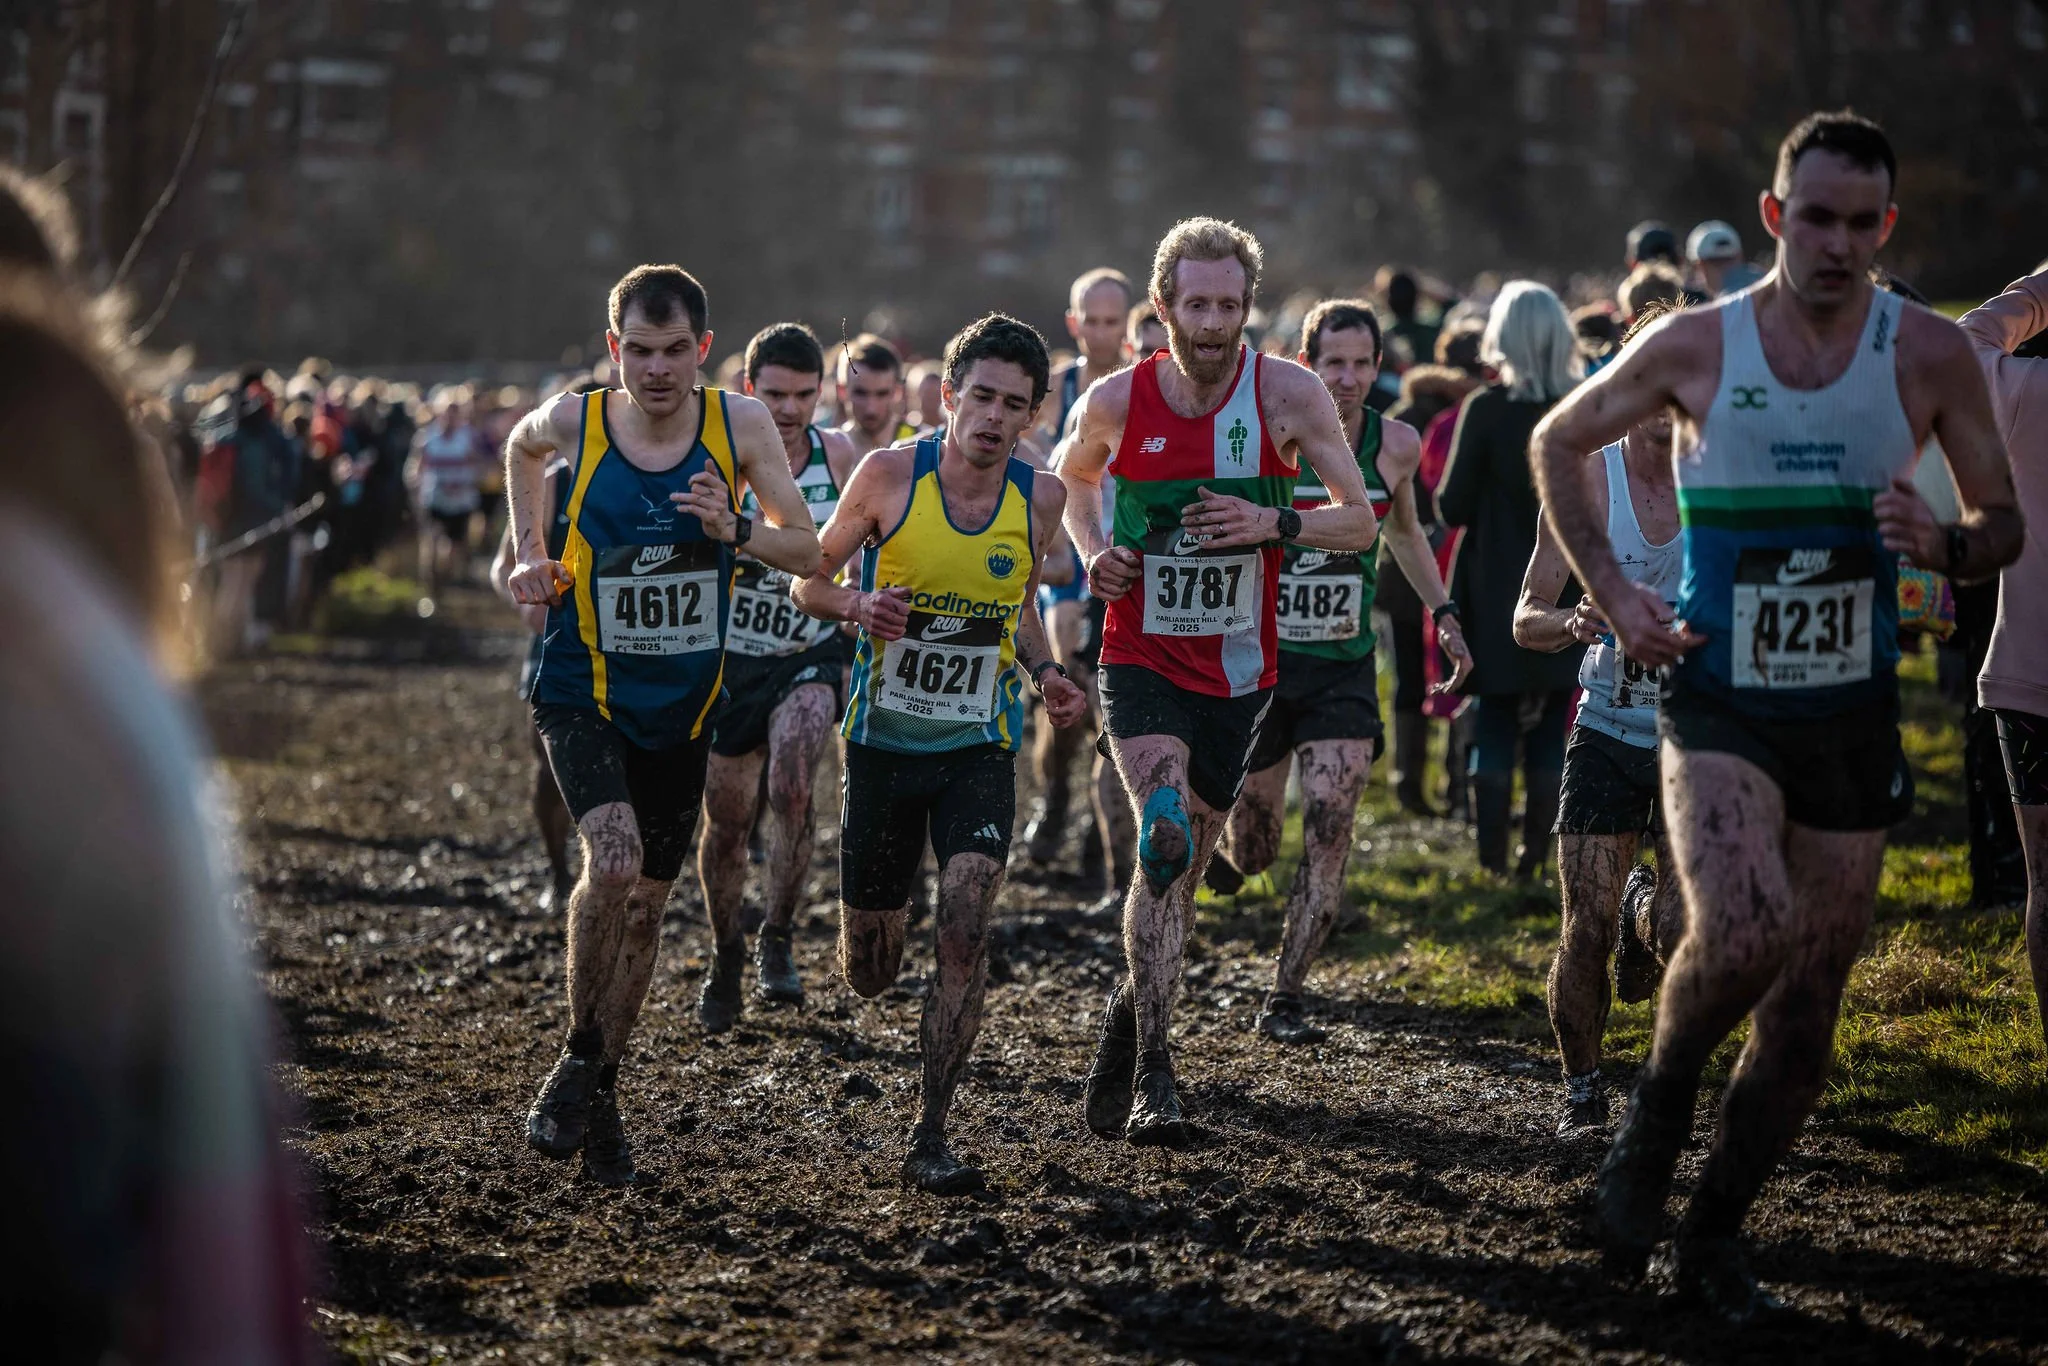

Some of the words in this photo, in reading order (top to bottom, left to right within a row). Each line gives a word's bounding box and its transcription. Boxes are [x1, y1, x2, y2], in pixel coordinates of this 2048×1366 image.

[1771, 441, 1845, 457] clapham
[1776, 458, 1839, 472] chasers
[640, 545, 675, 562] RUN
[1299, 551, 1328, 565] RUN
[1788, 548, 1832, 569] RUN
[1157, 564, 1243, 610] 3787
[615, 582, 702, 629] 4612
[1276, 583, 1351, 619] 5482
[733, 595, 810, 642] 5862
[930, 616, 966, 632] RUN
[1155, 615, 1200, 623] PARLIAMENT
[1754, 595, 1855, 655] 4231
[1172, 624, 1200, 632] 2025
[614, 634, 661, 642] PARLIAMENT
[662, 634, 680, 642] HILL
[632, 642, 661, 651] 2025
[896, 648, 985, 695] 4621
[889, 691, 935, 707] PARLIAMENT
[905, 702, 933, 715] 2025
